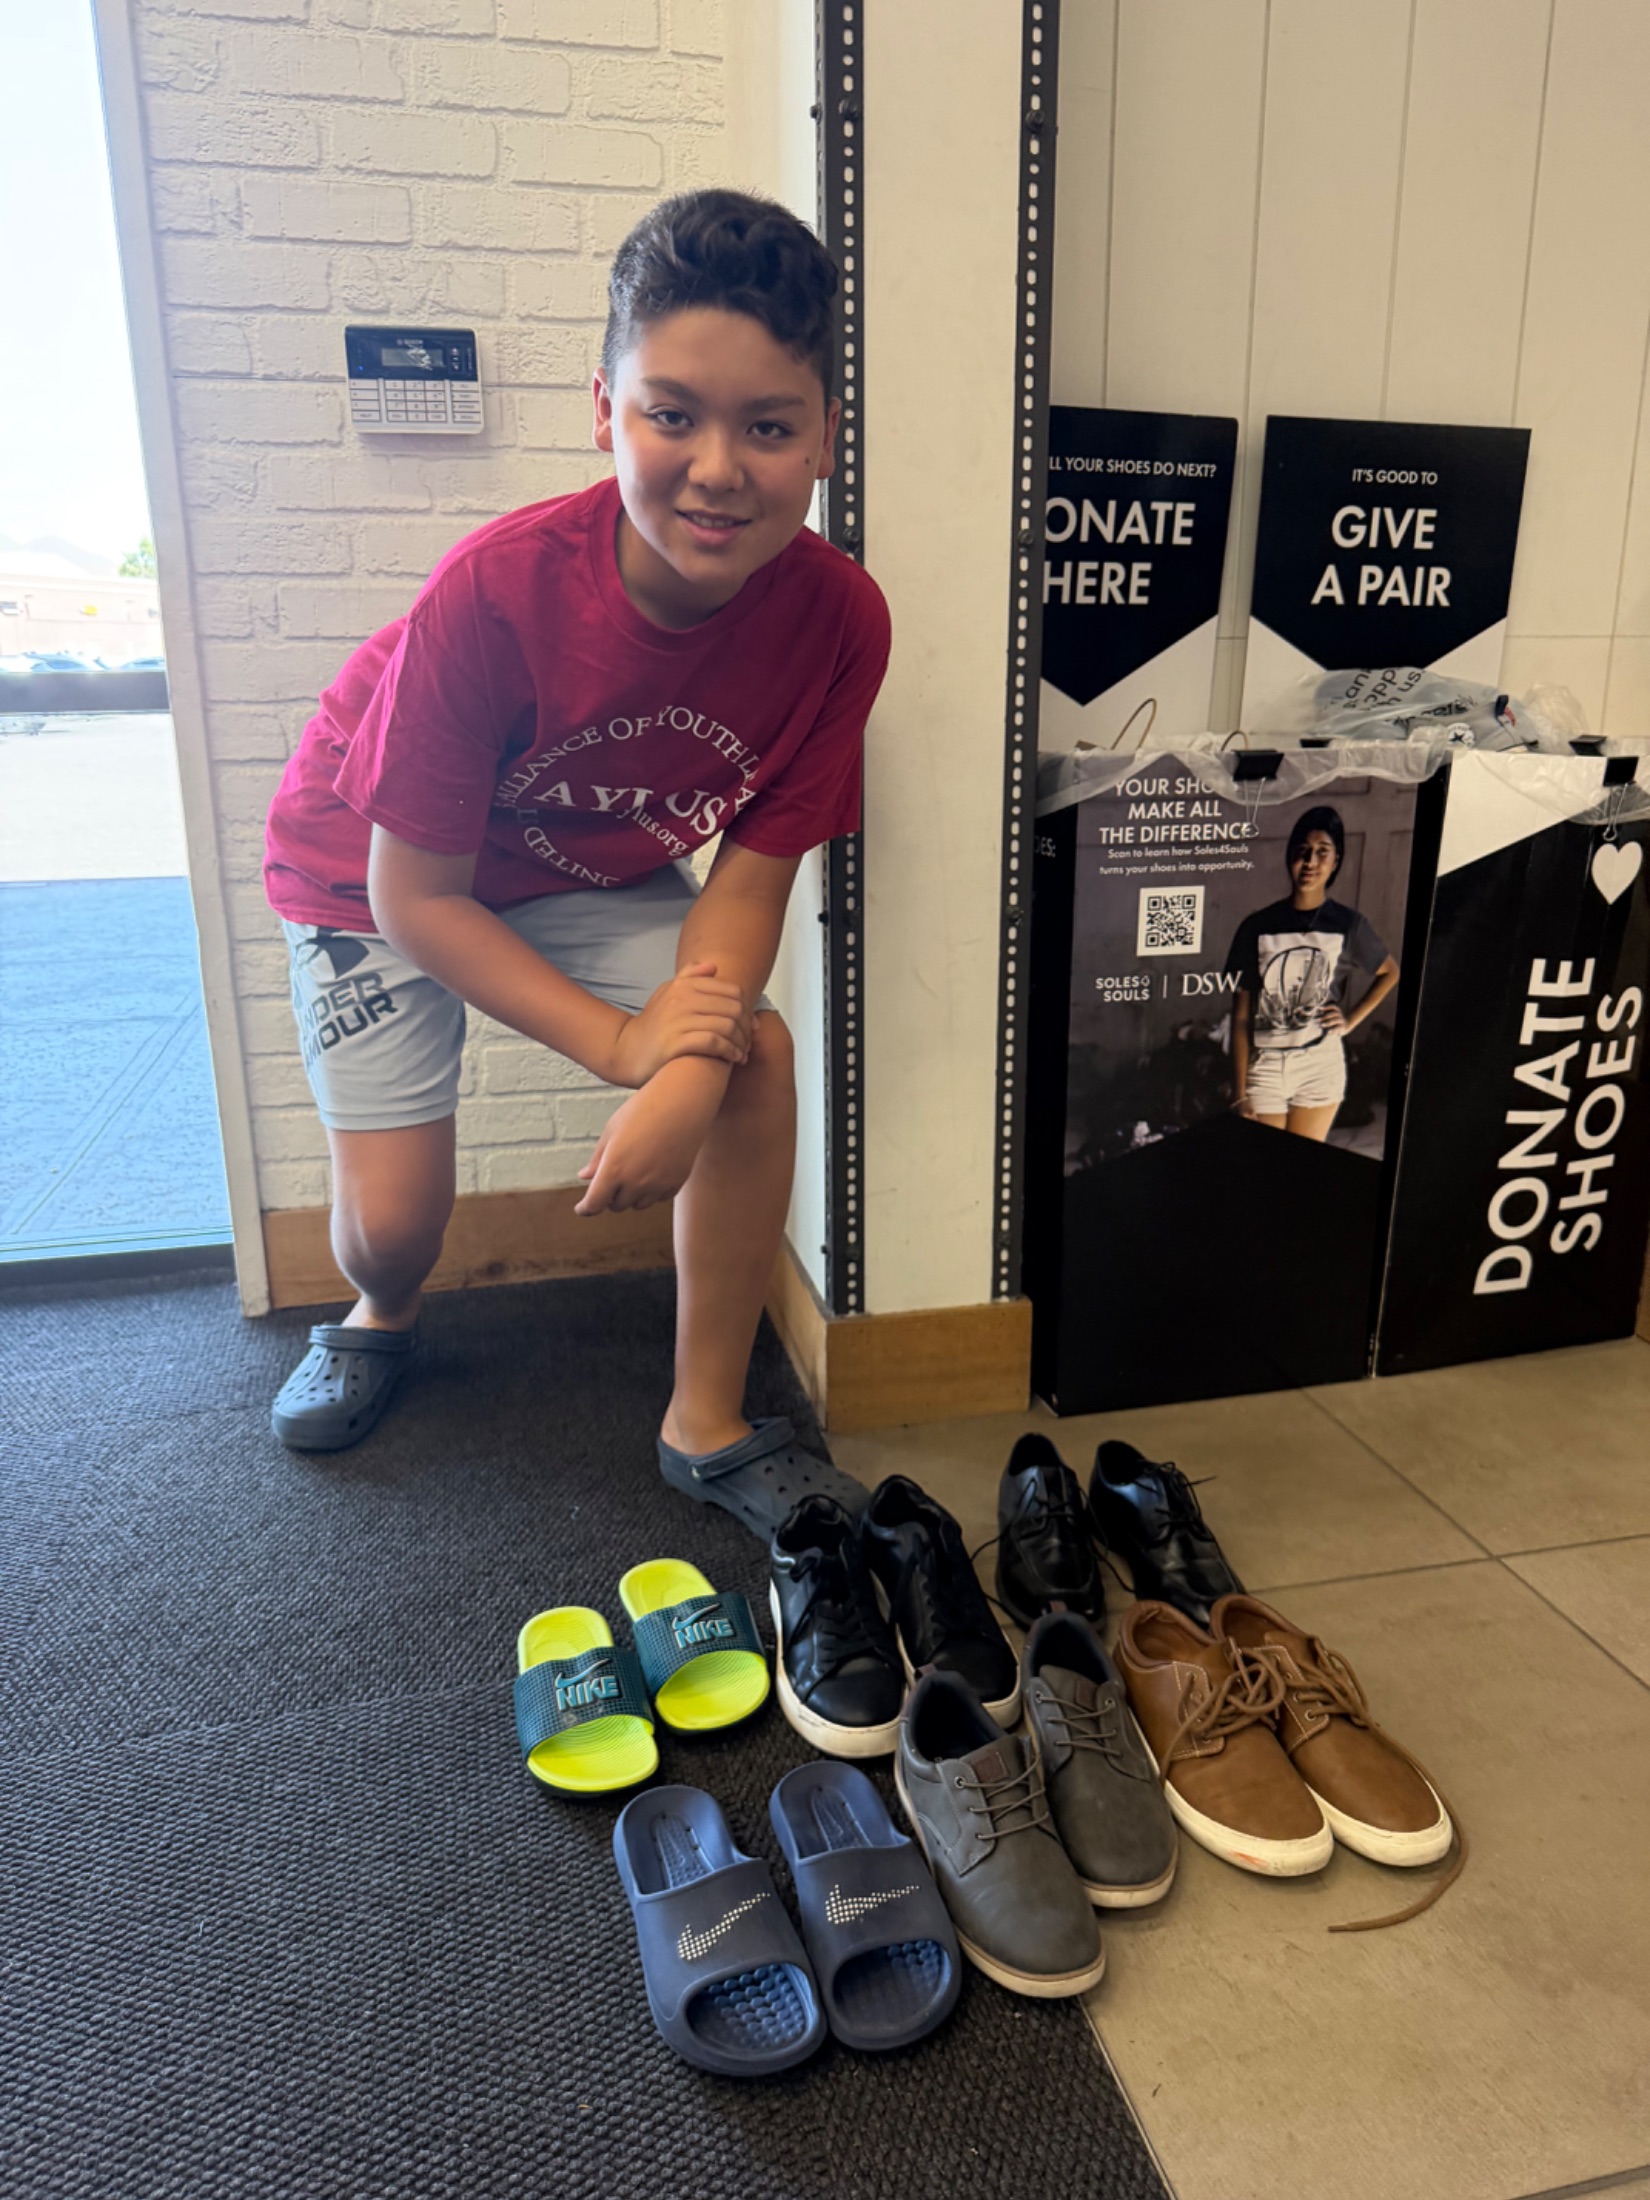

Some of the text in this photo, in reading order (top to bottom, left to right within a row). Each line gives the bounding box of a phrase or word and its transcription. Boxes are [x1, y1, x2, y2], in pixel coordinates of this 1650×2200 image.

[1049, 457, 1217, 478] LL YOUR SHOES DO NEXT?
[1352, 468, 1438, 486] IT'S GOOD TO
[1045, 497, 1196, 545] ONATE
[1331, 505, 1437, 550] GIVE
[1043, 561, 1152, 605] HERE
[1311, 564, 1451, 607] A PAIR
[608, 716, 652, 740] OF
[655, 705, 749, 763] YOUTH
[1115, 776, 1216, 797] YOUR SHO
[1127, 799, 1222, 820] MAKE ALL
[1100, 822, 1253, 845] THE DIFFERENCE
[1108, 843, 1249, 860] Scan to learn how Soles4Souls
[1100, 858, 1255, 877] turns your shoes into opportunity.
[1103, 988, 1150, 1003] SOULS
[1181, 970, 1243, 996] DSW
[304, 971, 387, 1029] NDER
[1473, 957, 1596, 1295] DONATE
[1550, 985, 1643, 1254] SHOES
[675, 1618, 735, 1649] NIKE
[556, 1675, 620, 1711] NIKE
